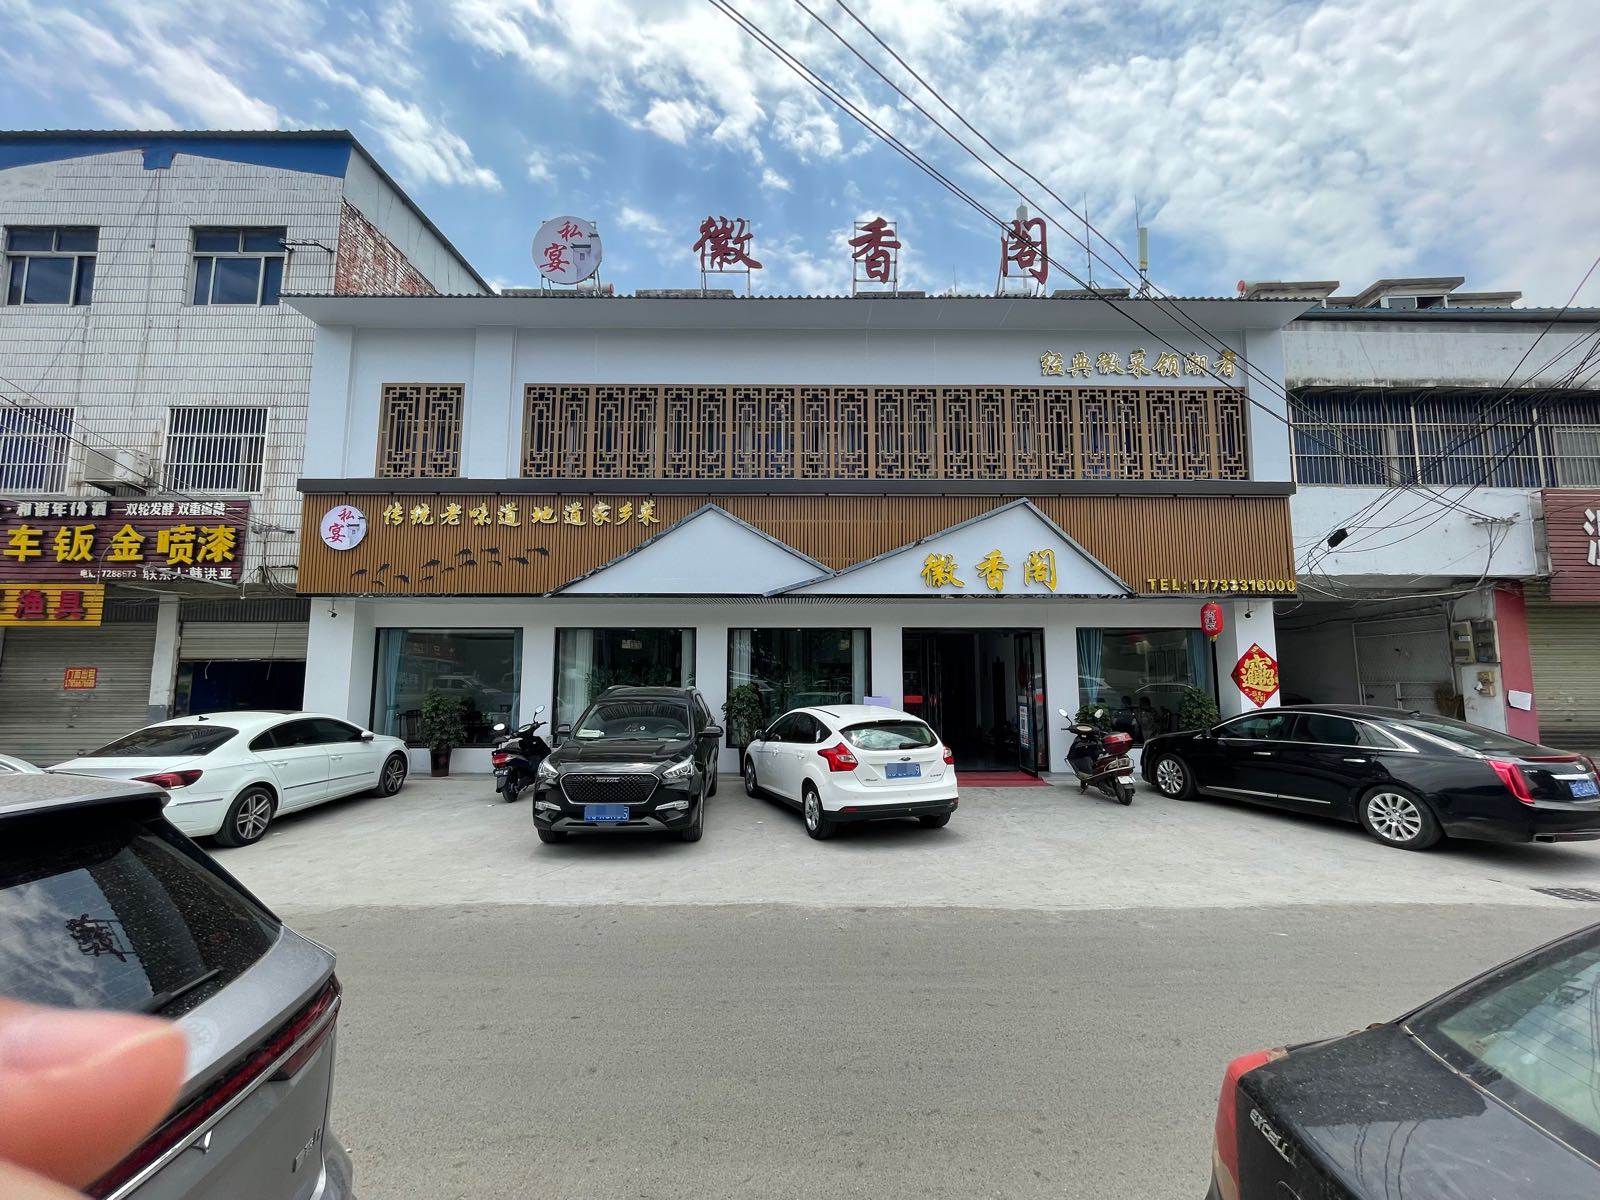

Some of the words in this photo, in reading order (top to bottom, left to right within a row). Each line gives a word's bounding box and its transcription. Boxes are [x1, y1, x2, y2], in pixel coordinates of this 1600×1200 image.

[539, 220, 584, 273] 私宴
[1040, 347, 1239, 378] 经典徽菜领潮者
[3, 523, 237, 565] 车钣金喷漆
[325, 508, 355, 544] 私宴
[920, 547, 1059, 593] 徽香阁
[14, 590, 86, 619] 渔具
